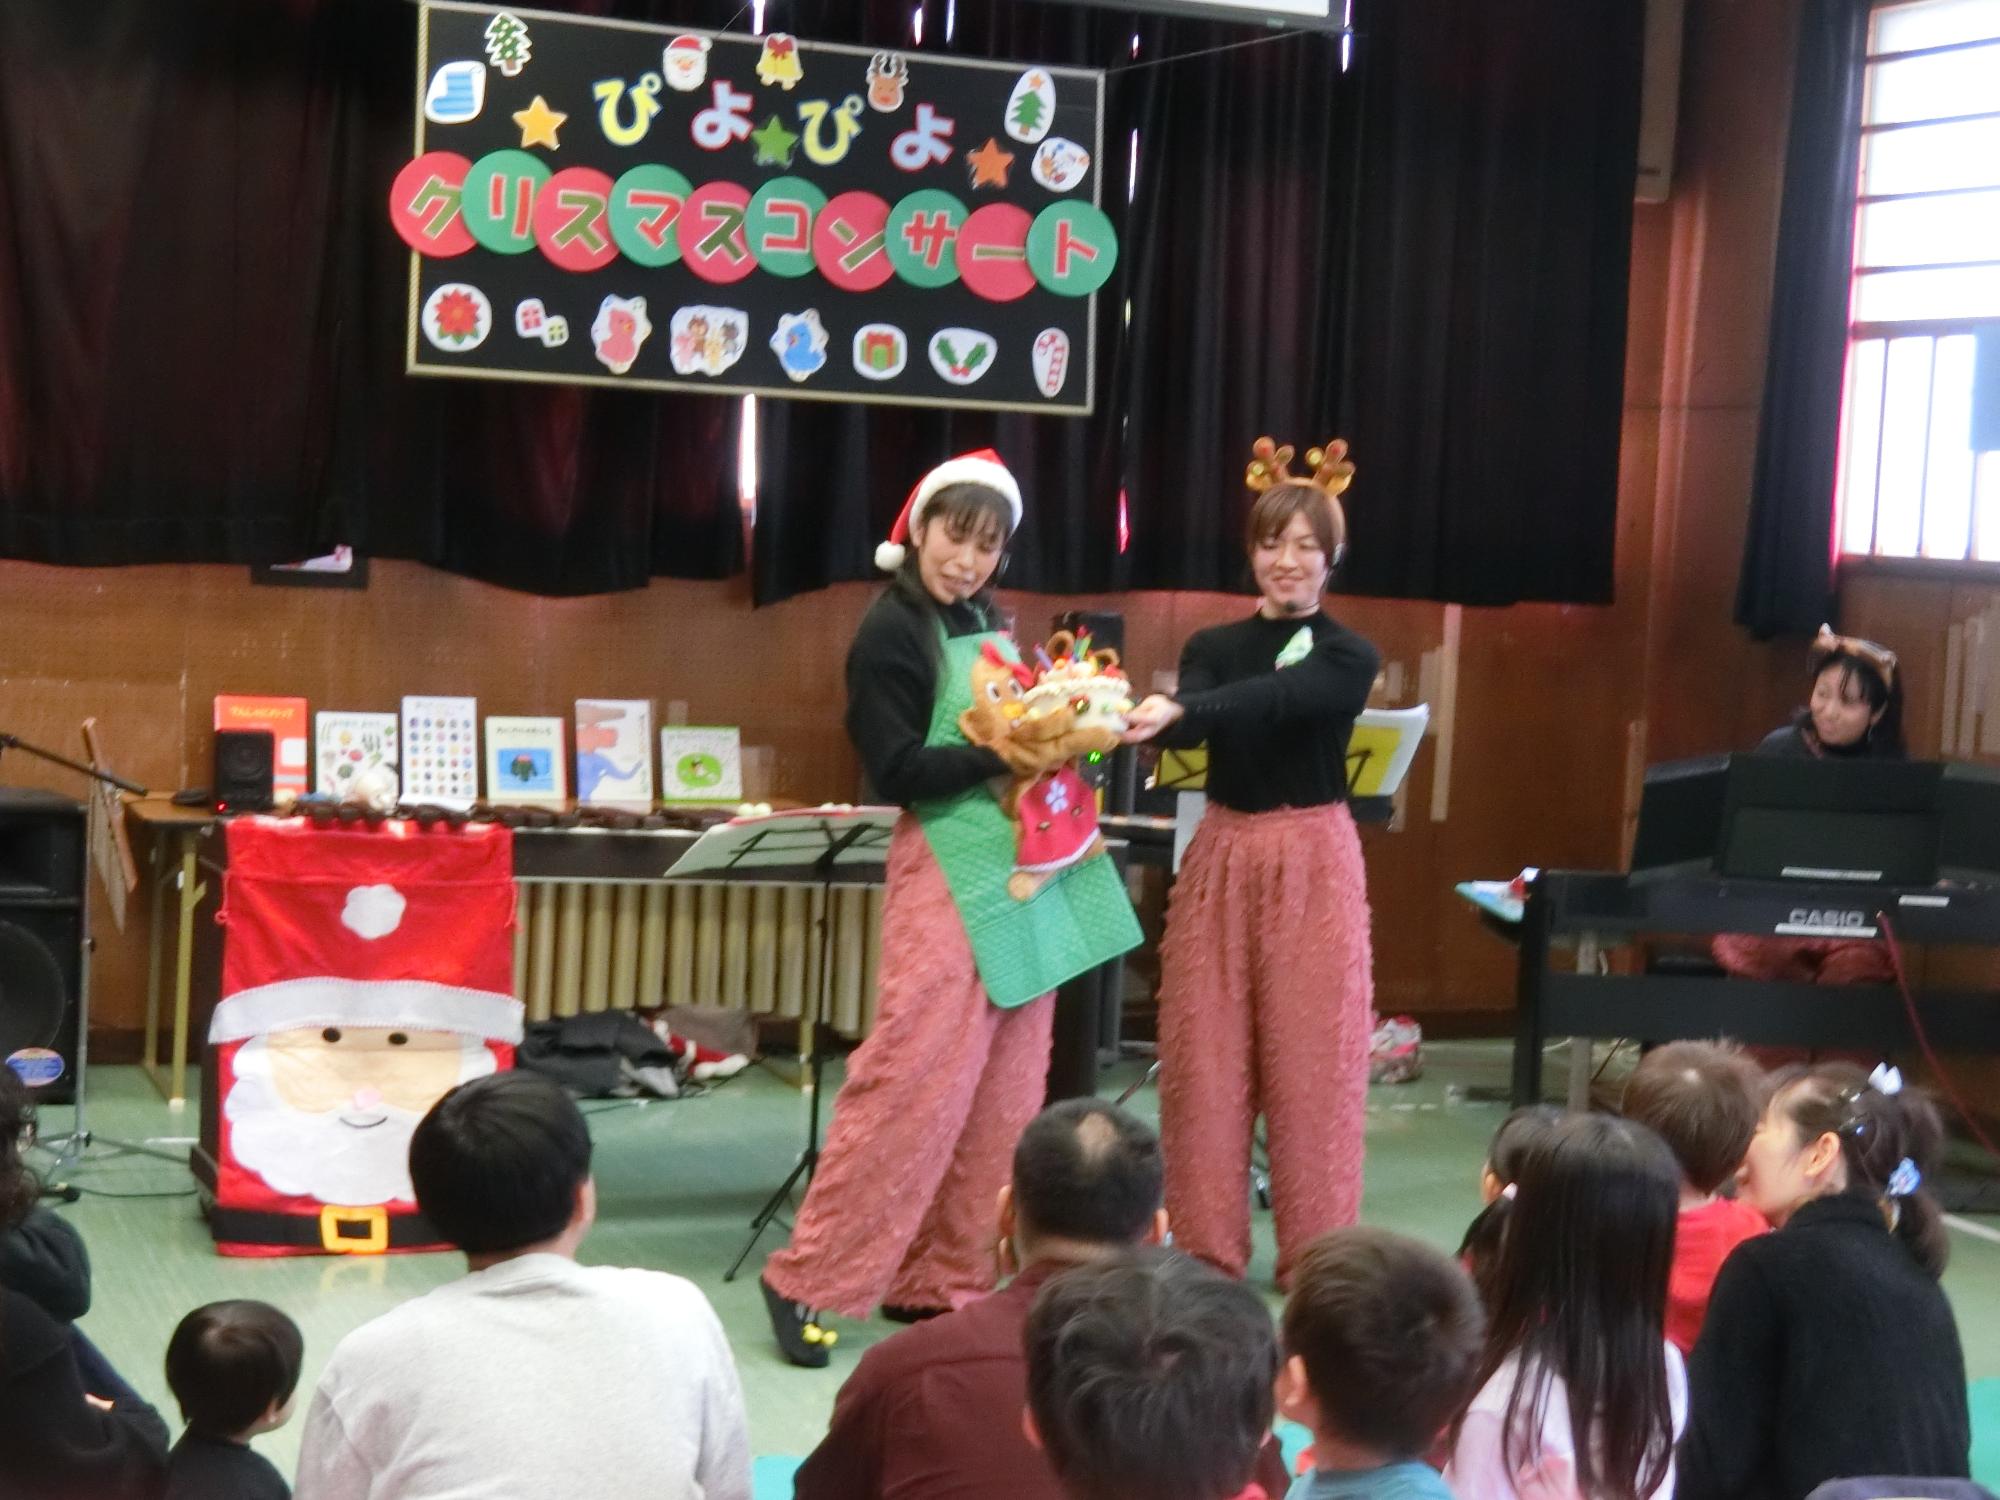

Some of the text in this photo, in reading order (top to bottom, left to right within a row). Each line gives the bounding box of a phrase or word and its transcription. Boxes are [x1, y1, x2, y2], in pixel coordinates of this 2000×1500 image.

[408, 173, 1099, 279] クリスマスコンサート
[1788, 908, 1865, 928] CASIO
